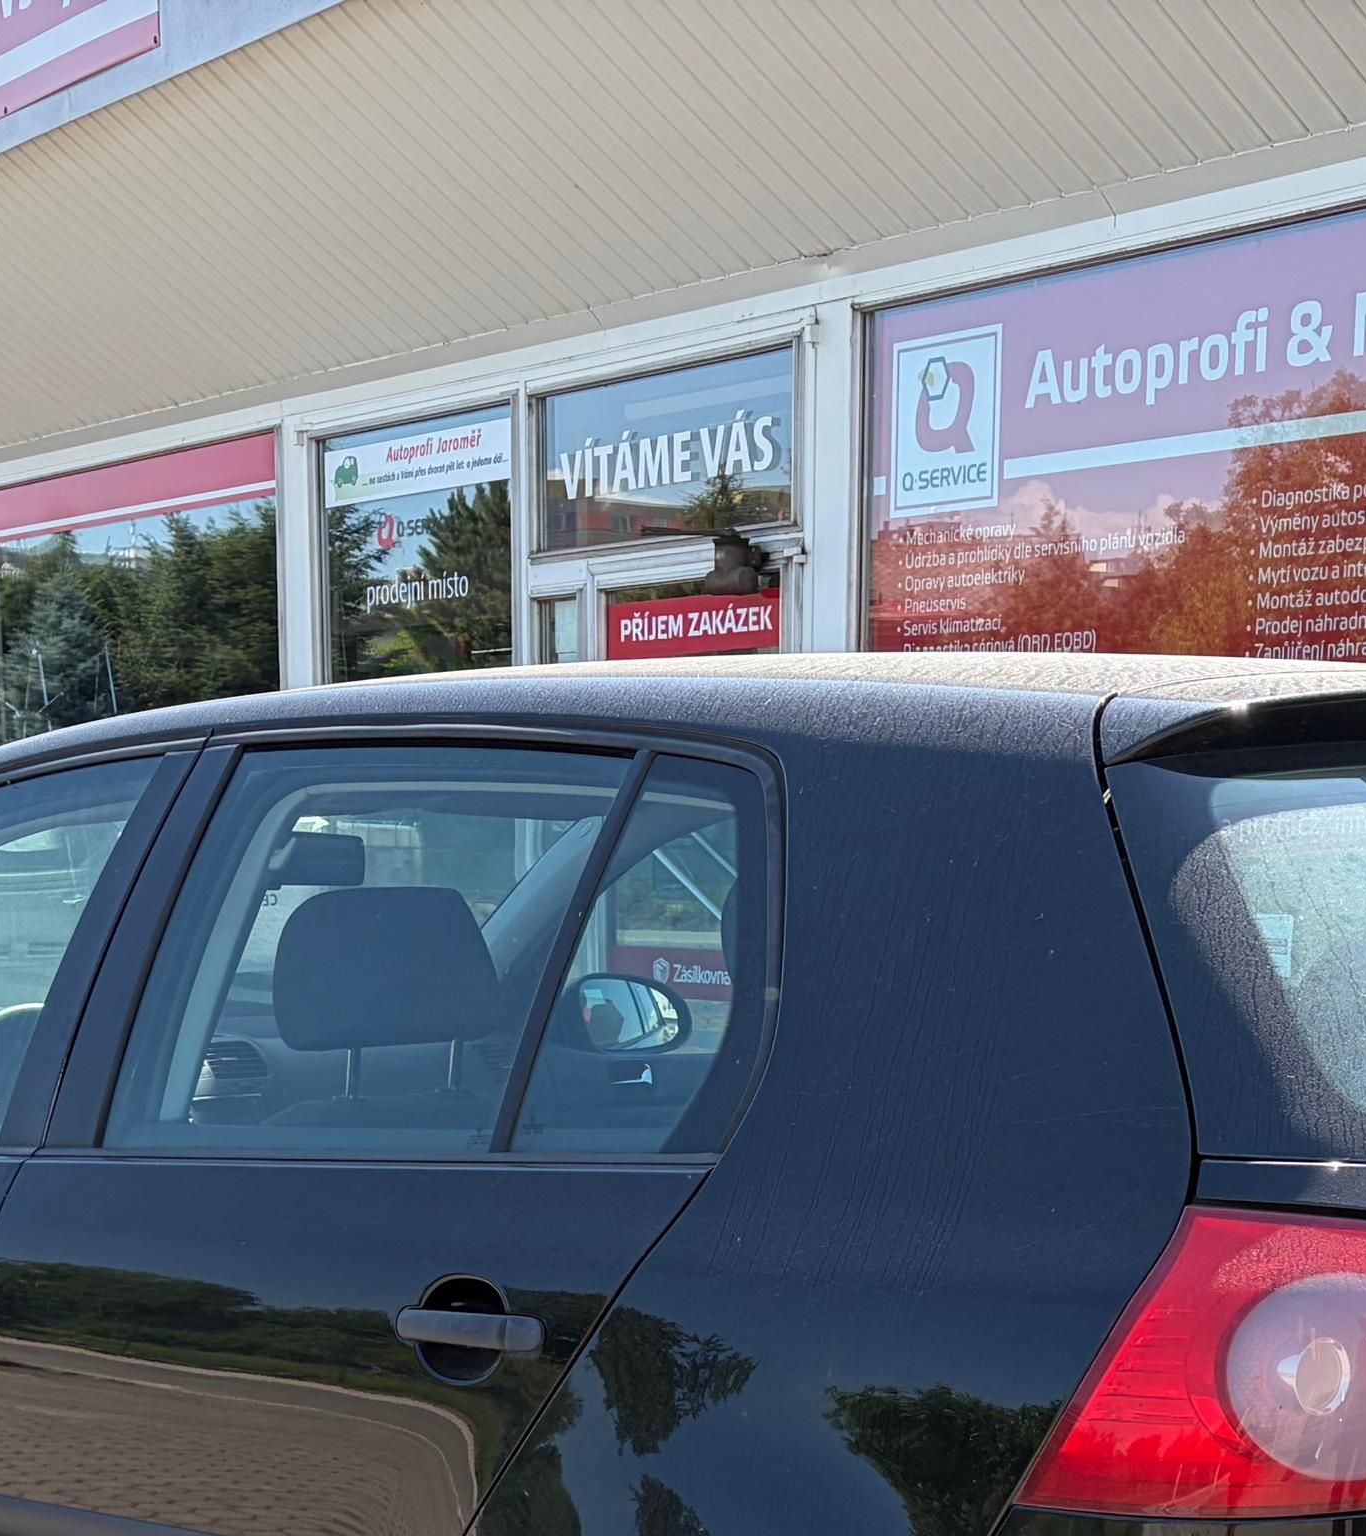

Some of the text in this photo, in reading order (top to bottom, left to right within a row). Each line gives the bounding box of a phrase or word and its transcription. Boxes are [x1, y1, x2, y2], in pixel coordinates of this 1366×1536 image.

[1025, 307, 1269, 409] Autoprofi
[1286, 300, 1333, 367] &
[386, 429, 482, 464] Autoprofi Jaroměř
[559, 408, 774, 500] VÍTÁME VÁS
[1261, 484, 1350, 510] Diagnostika
[906, 523, 1015, 546] Mechanické opravy
[1259, 509, 1318, 537] Výměny
[905, 549, 946, 569] Údržba
[948, 553, 955, 565] a
[957, 544, 1012, 568] prohlídky
[1013, 542, 1032, 559] dle
[1035, 536, 1098, 557] servisního
[1138, 527, 1185, 546] vozidla
[1258, 537, 1315, 560] Montáž
[905, 565, 1026, 593] Opravy autoelektriky
[1257, 563, 1291, 588] Mytí
[1293, 564, 1328, 582] vozu
[1331, 562, 1340, 579] a
[367, 571, 469, 614] prodejní místo
[904, 595, 966, 614] Pneuservis
[1256, 587, 1313, 610] Montáž
[620, 604, 773, 642] PŘÍJEM ZAKÁZEK
[903, 618, 938, 637] Servis
[1255, 617, 1303, 641] Prodej
[673, 964, 731, 986] Zásilkovna
